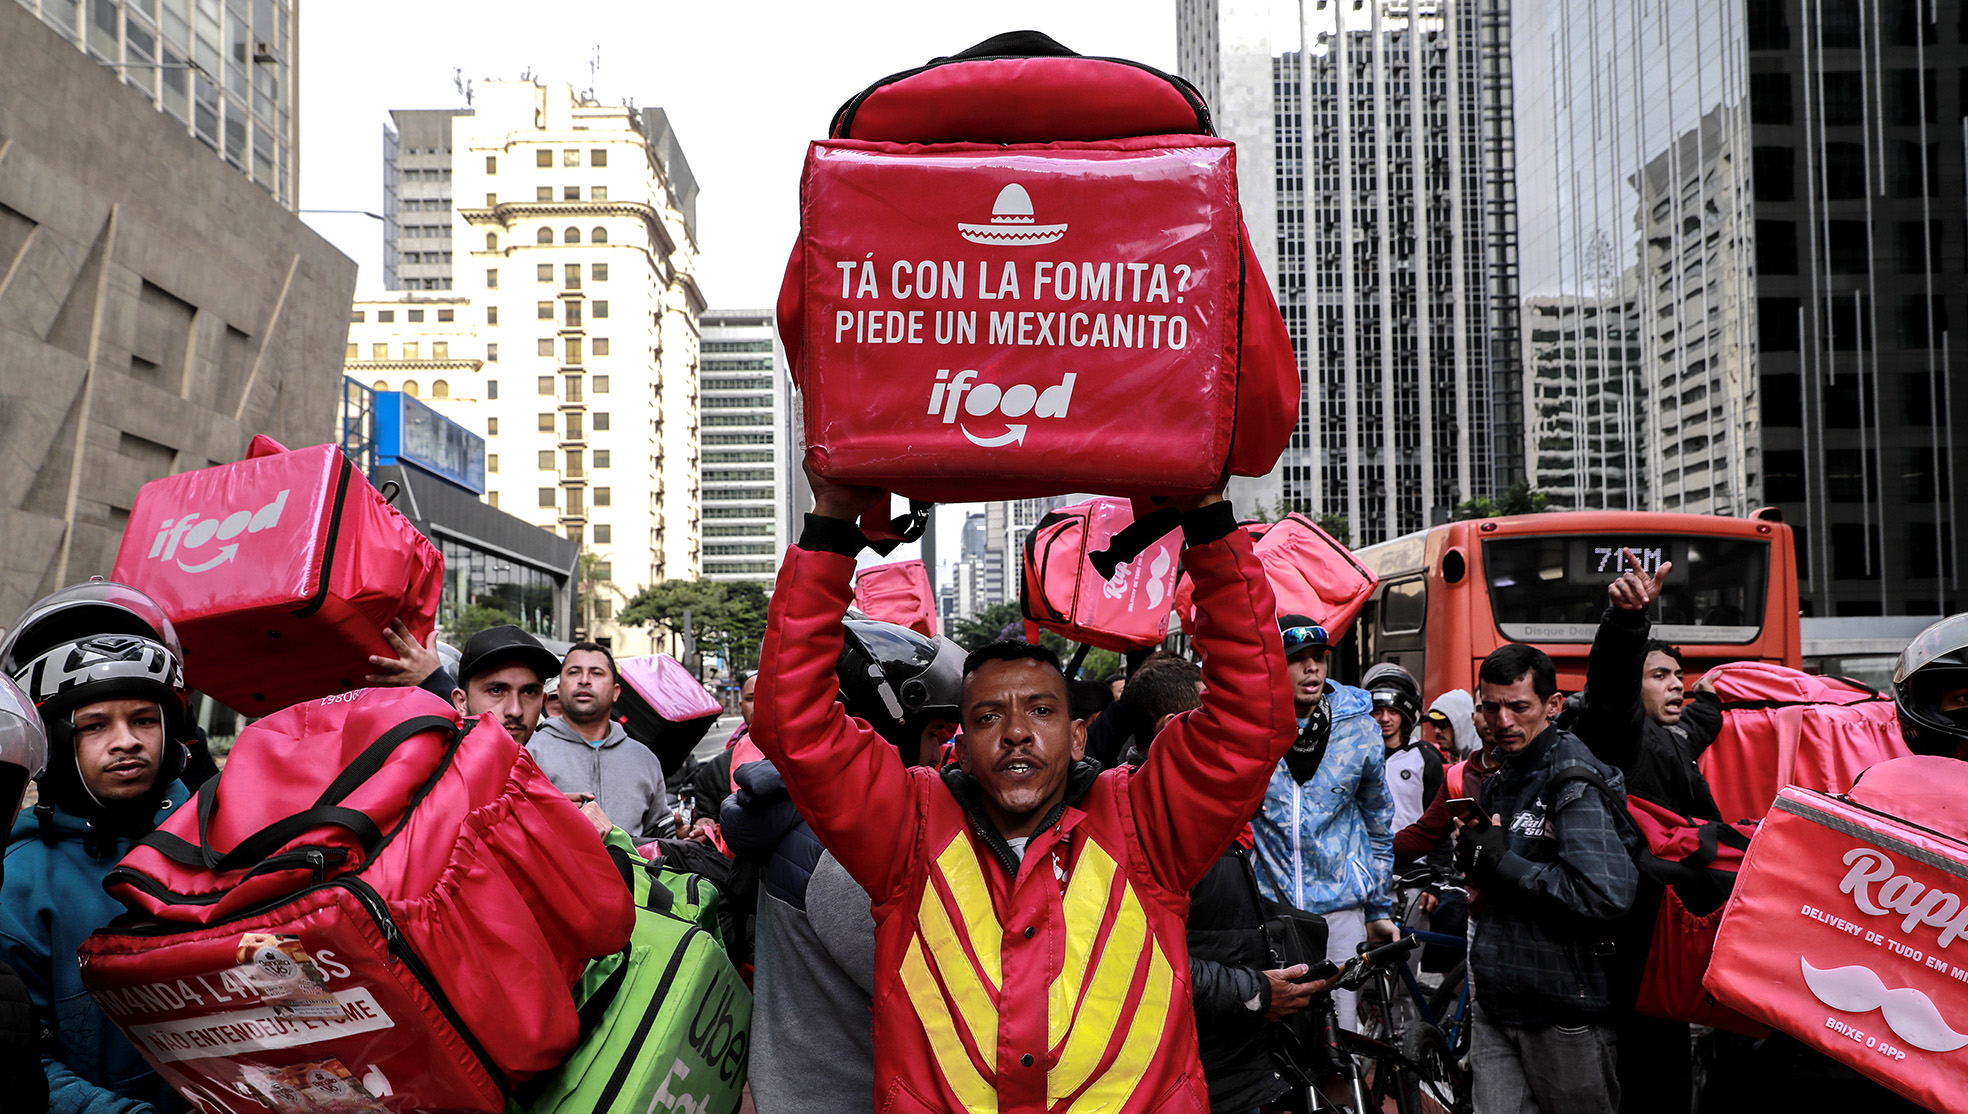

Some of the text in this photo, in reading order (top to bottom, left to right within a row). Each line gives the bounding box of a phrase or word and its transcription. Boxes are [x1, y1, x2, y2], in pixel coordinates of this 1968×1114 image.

[836, 253, 1192, 304] TÁ CON LA FOMITA?
[835, 310, 1188, 351] PIEDE UN MEXICANITO
[928, 369, 1077, 424] ifood
[147, 488, 291, 562] ifood
[1524, 626, 1565, 637] Disque
[1801, 904, 1863, 937] DELIVERY
[1865, 930, 1885, 946] DE
[1887, 938, 1923, 962] TUDO
[1925, 956, 1949, 974] EM
[147, 1029, 189, 1052] NÃO
[186, 1016, 299, 1048] ENTENDEU?
[1825, 1016, 1906, 1062] BAIXE O APP
